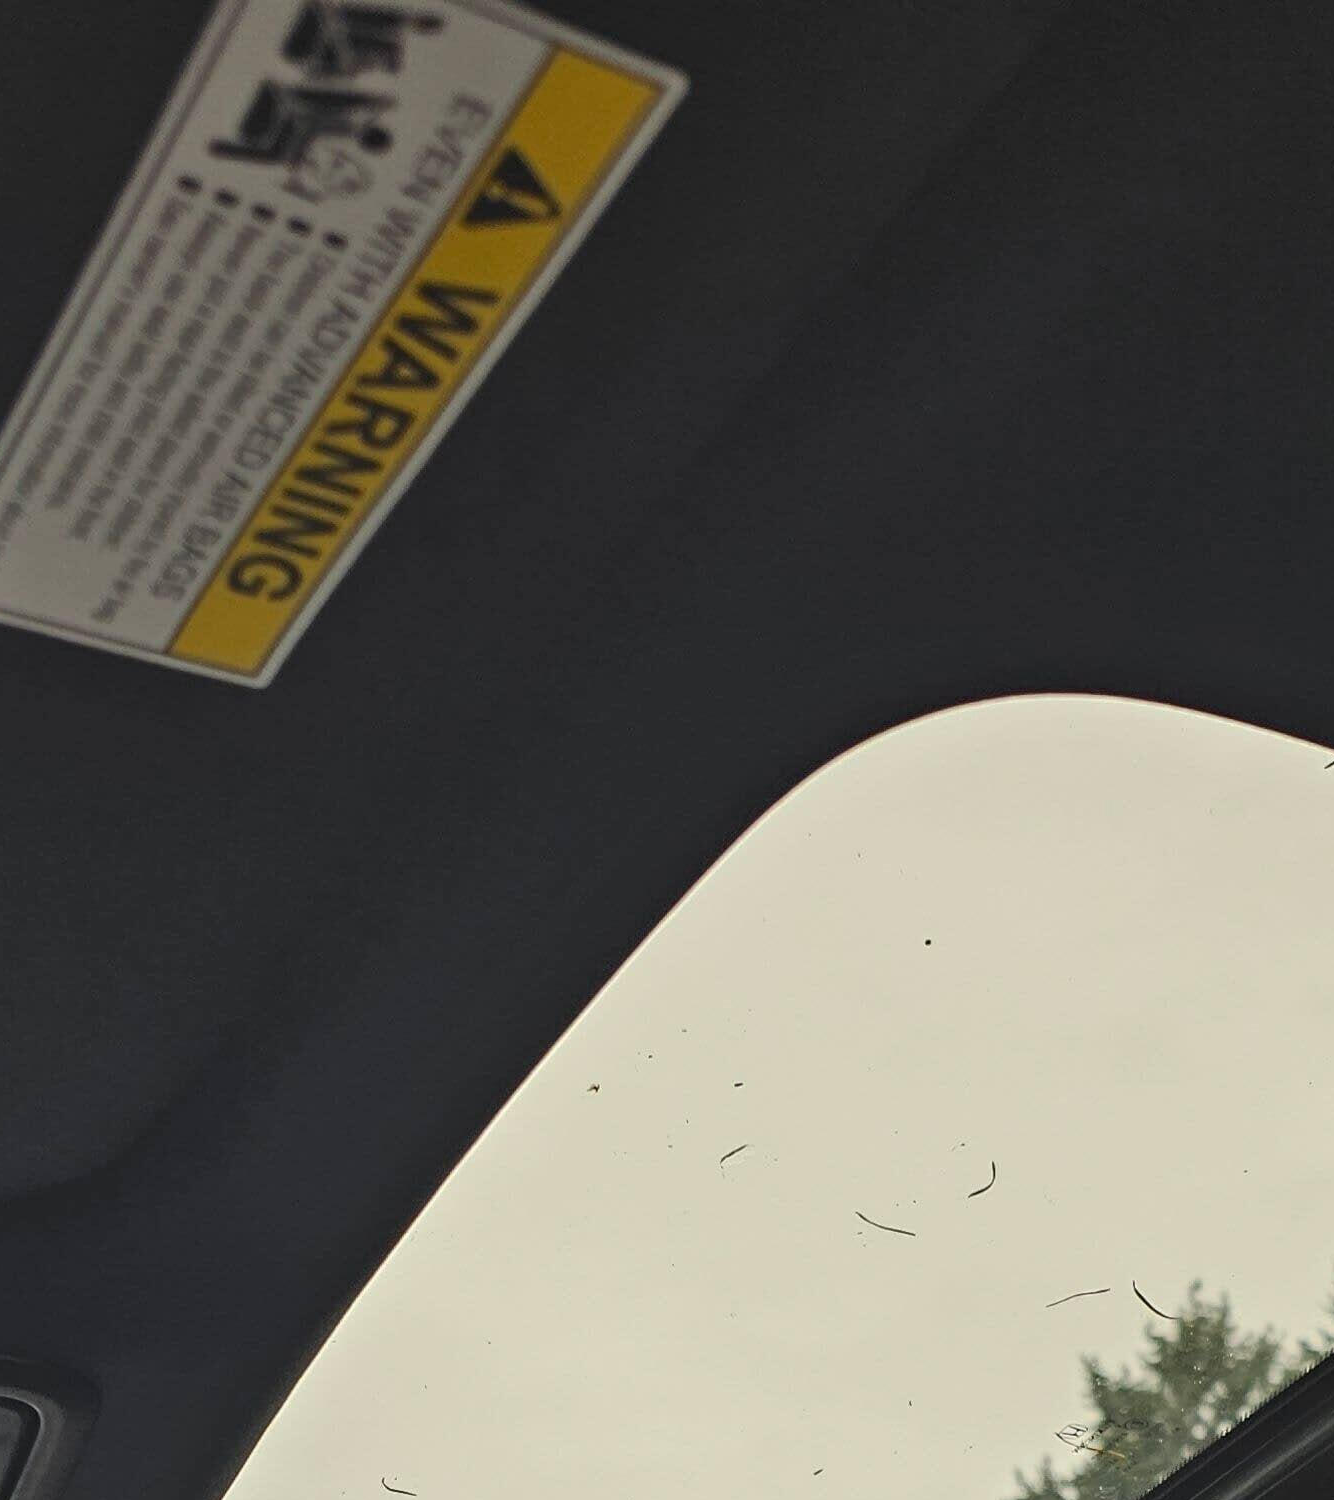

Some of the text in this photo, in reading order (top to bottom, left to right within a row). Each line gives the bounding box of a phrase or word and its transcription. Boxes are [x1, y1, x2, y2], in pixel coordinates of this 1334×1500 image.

[150, 92, 493, 600] EVEN WITH ADVANCED AIR BAGS
[227, 280, 501, 602] WARNING
